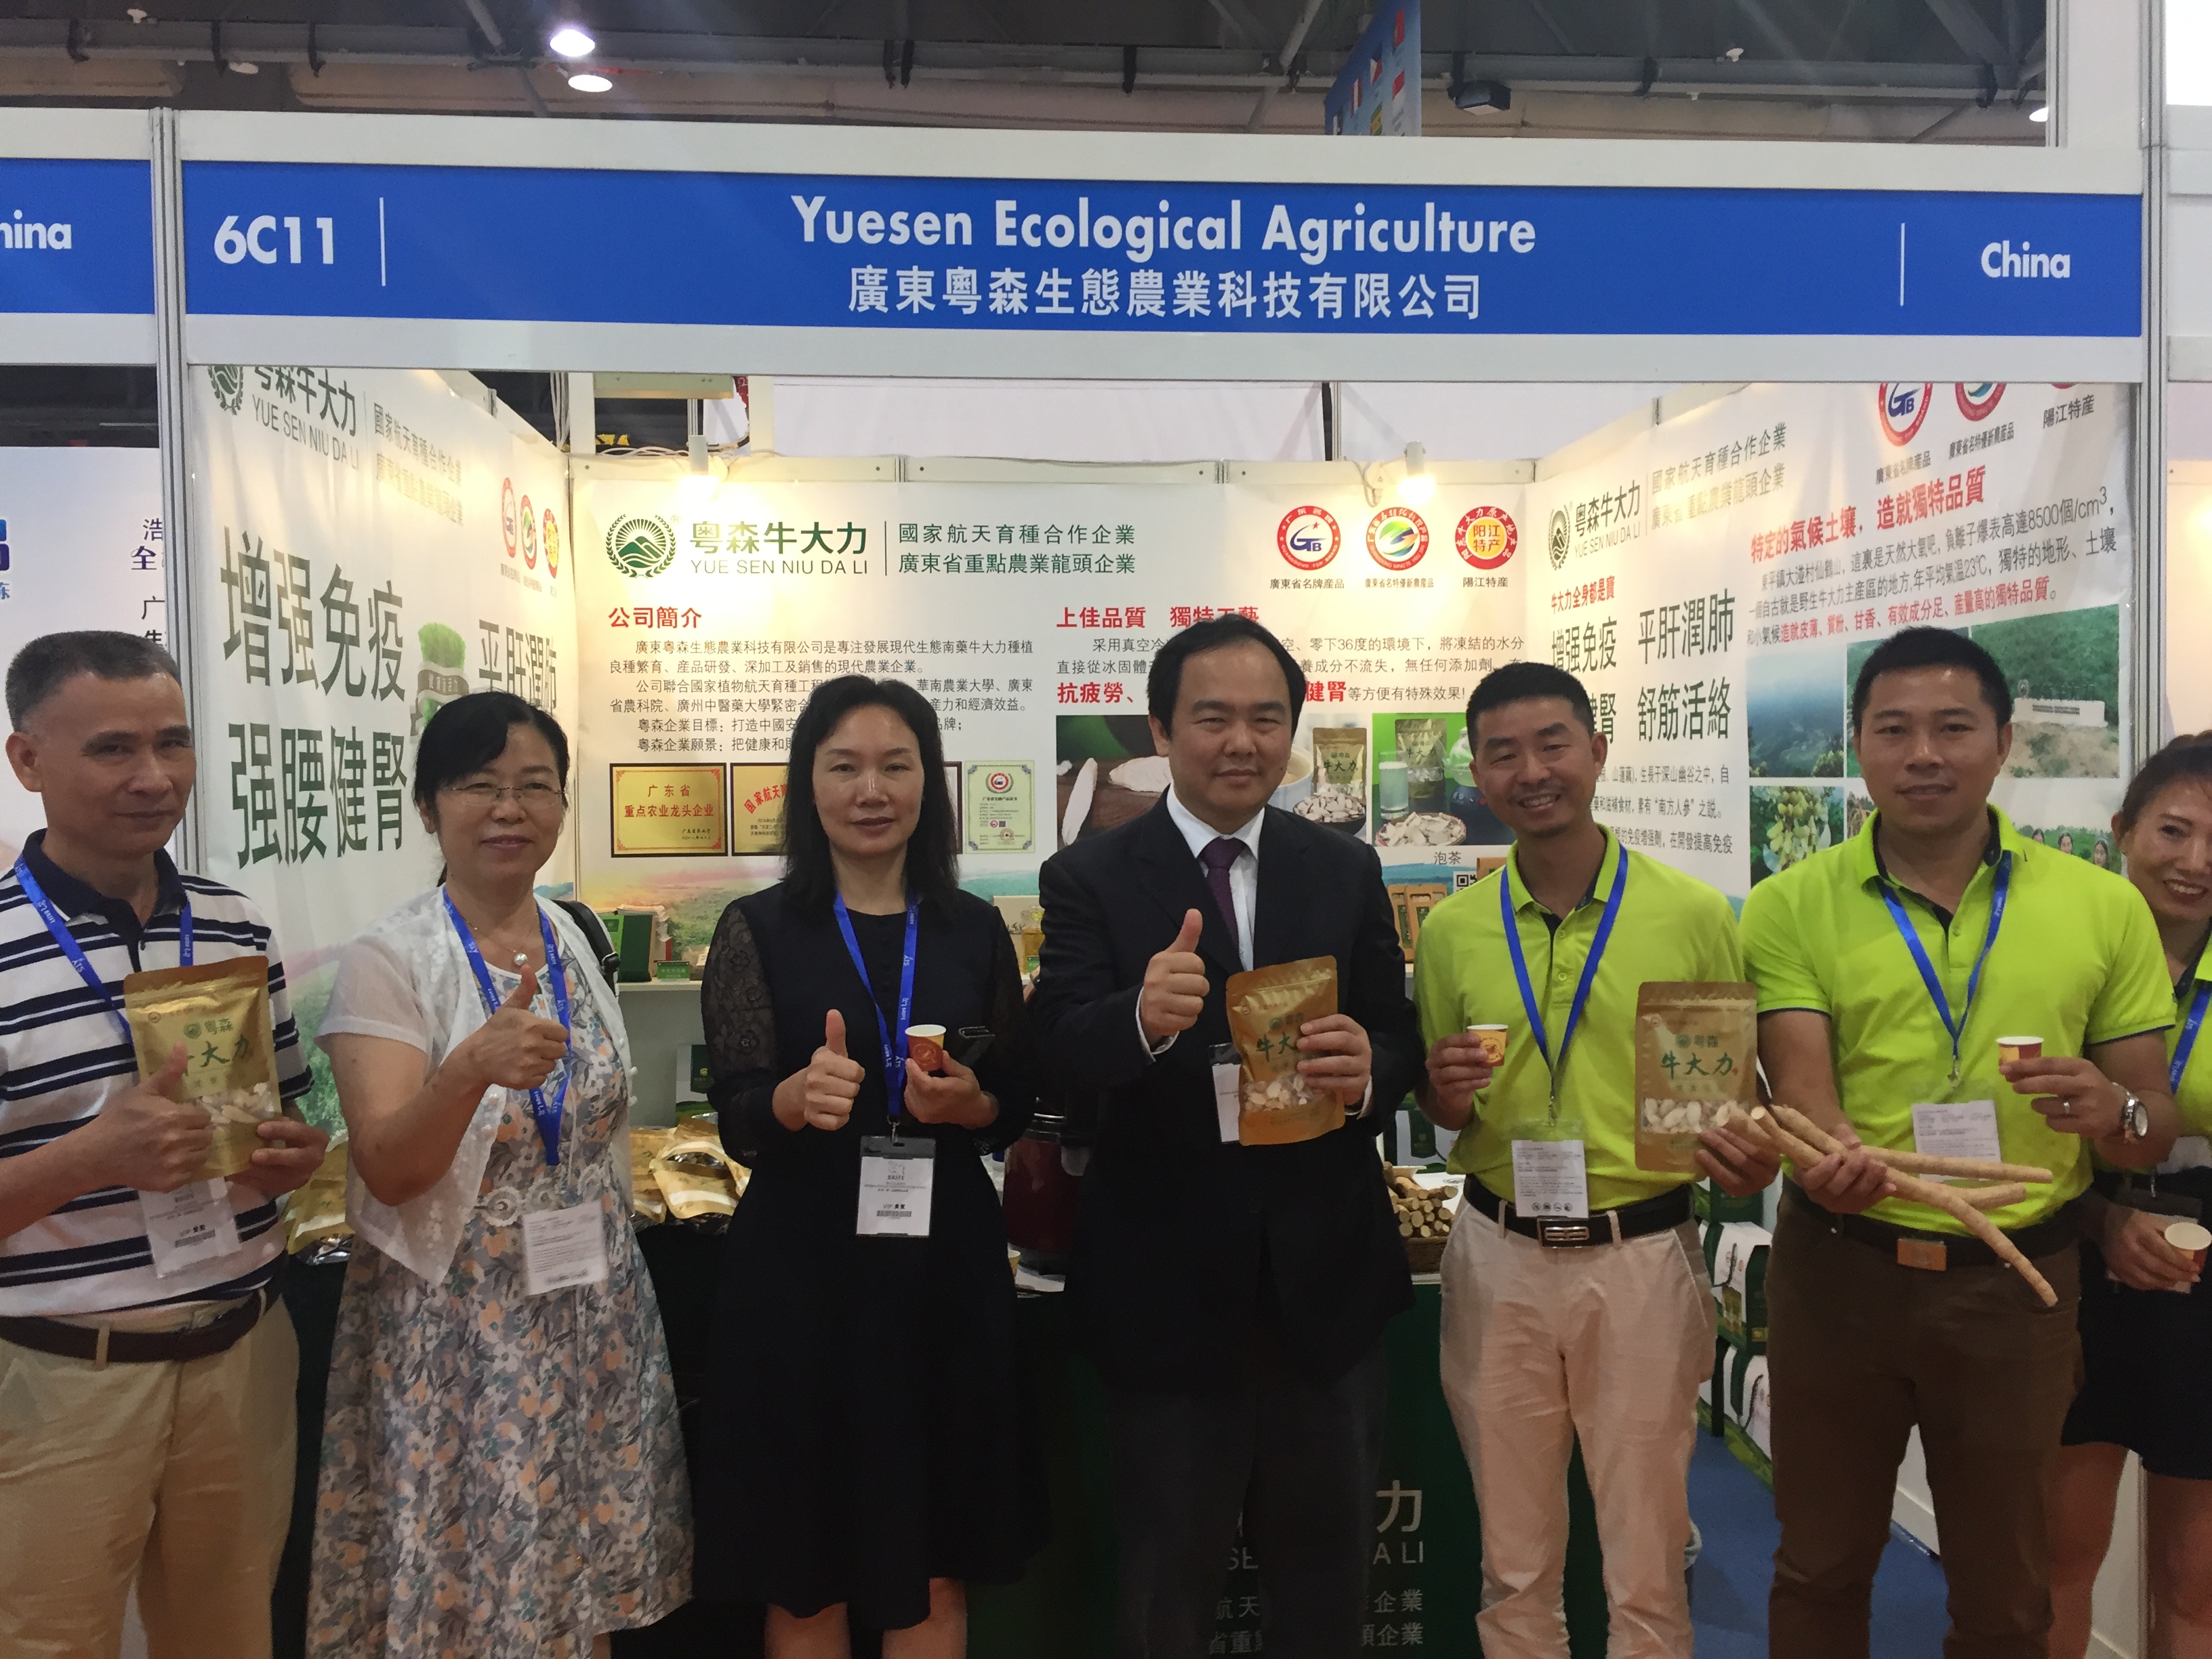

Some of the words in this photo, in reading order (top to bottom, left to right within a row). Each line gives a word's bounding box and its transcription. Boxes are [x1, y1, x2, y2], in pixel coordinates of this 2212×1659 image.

[213, 215, 335, 265] 6C11
[791, 195, 973, 246] Yuesen
[996, 197, 1241, 262] Ecological
[1261, 203, 1536, 265] Agriculture
[1981, 240, 2070, 279] China
[252, 394, 279, 432] YUE
[284, 411, 306, 445] SEN
[310, 425, 329, 455] NIU
[333, 437, 348, 464] DA
[351, 449, 359, 469] LI
[1652, 422, 1786, 495] 國家航天育種合作企業
[899, 523, 1135, 544] 國家航天育種合作企業
[1473, 524, 1500, 537] 阳江
[1574, 538, 1588, 558] YUE
[1590, 533, 1604, 555] SEN
[1606, 529, 1619, 550] NIU
[1620, 525, 1631, 544] DA
[1633, 522, 1641, 540] LI
[1473, 539, 1500, 552] 特产
[691, 560, 729, 573] YUE
[737, 560, 774, 573] SEN
[783, 560, 813, 574] NIU
[821, 560, 846, 574] DA
[853, 560, 867, 574] LI
[899, 552, 1135, 574] 廣東省重點農業龍頭企業
[220, 525, 405, 702] 增强免疫
[608, 606, 701, 628] 公司簡介
[1057, 607, 1146, 628] 上佳品質
[1552, 616, 1617, 673] 增强免疫
[1638, 588, 1735, 664] 平肝潤肺
[1092, 638, 1171, 653] 采用真空冷
[917, 678, 1033, 693] 華南農業大學、廣東
[1057, 682, 1134, 703] 抗疲勞、
[1637, 676, 1731, 743] 舒筋活絡
[1324, 757, 1356, 773] 牛大力
[228, 722, 407, 869] 强腰健腎
[648, 784, 691, 797] 广东省
[624, 804, 714, 817] 重点农业龙头企业
[1434, 851, 1461, 865] 泡茶
[1662, 1050, 1733, 1080] 牛大力
[1376, 1480, 1422, 1533] 力
